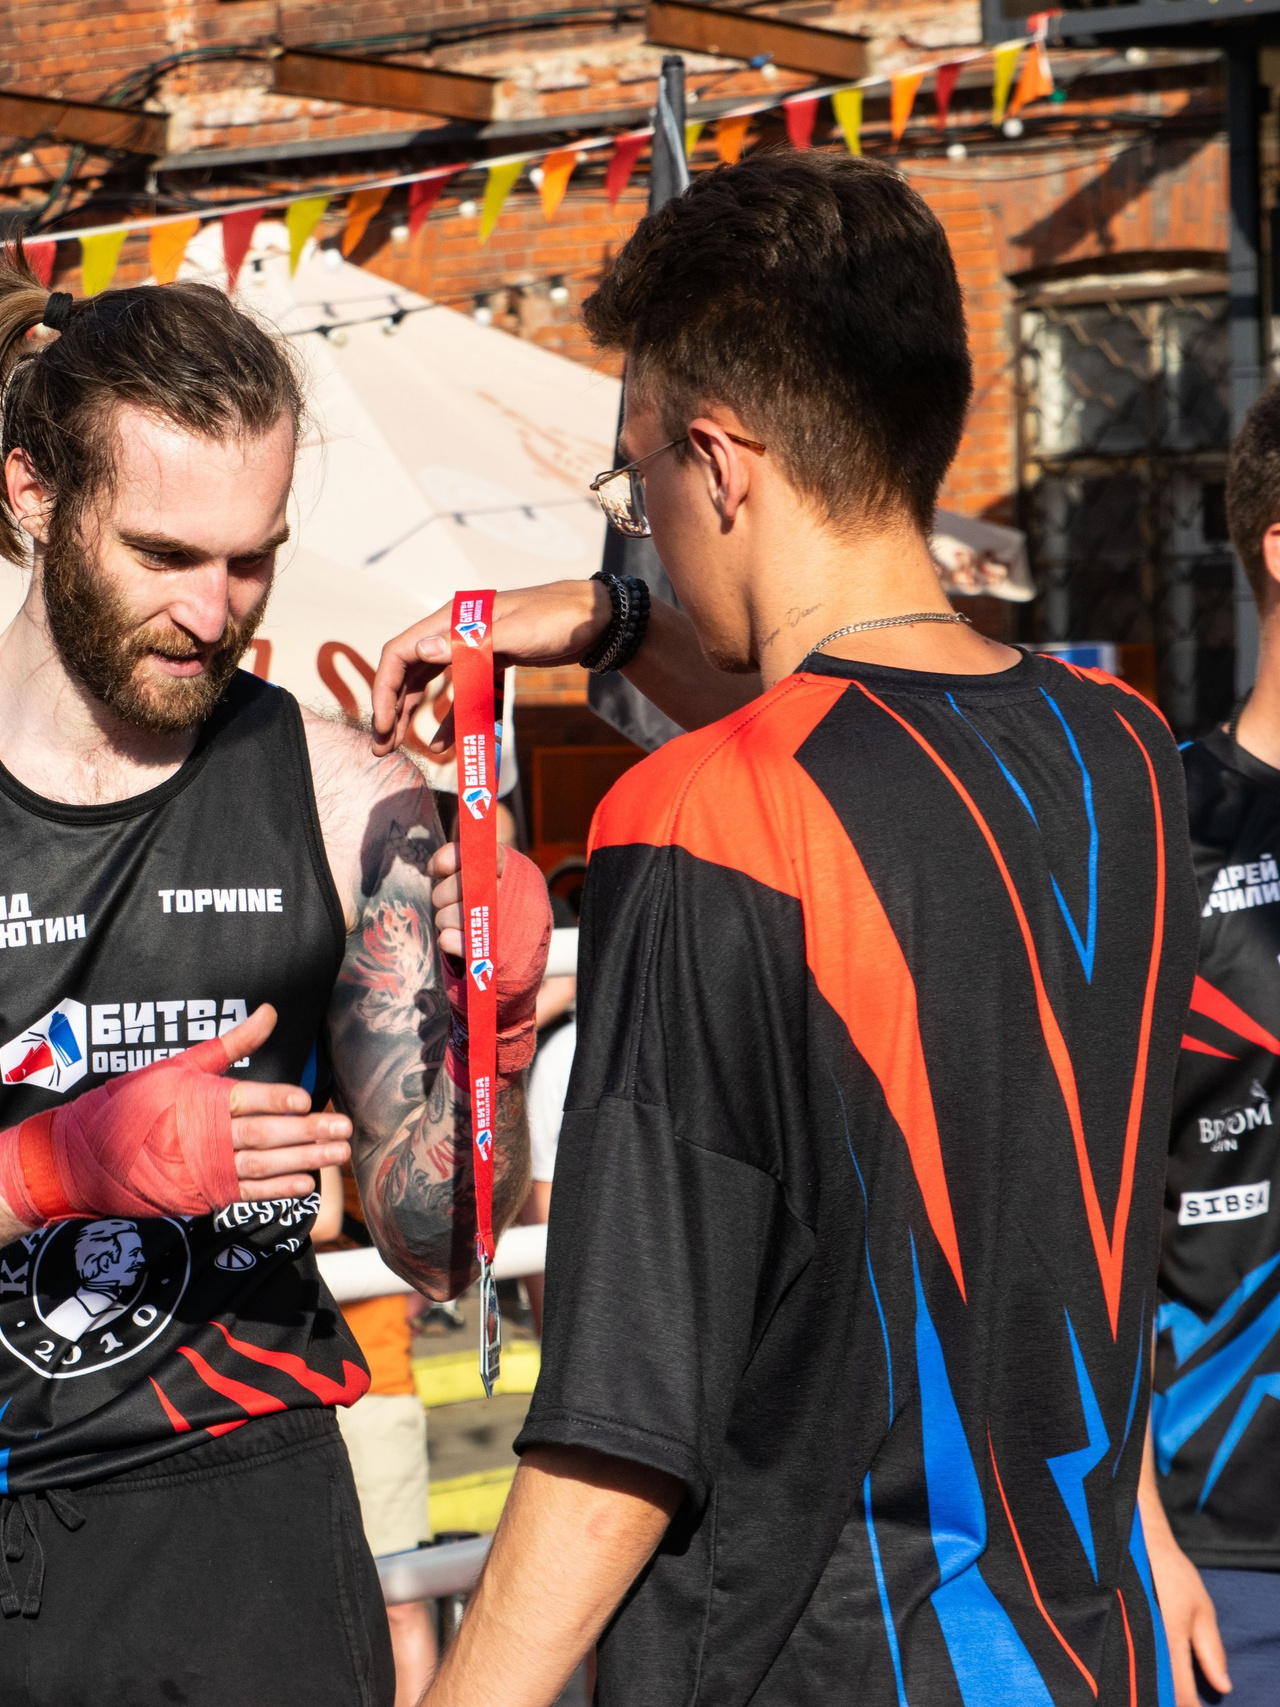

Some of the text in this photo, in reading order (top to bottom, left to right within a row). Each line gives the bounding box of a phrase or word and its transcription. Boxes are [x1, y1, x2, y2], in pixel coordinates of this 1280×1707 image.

[463, 734, 478, 786] БИТВА
[478, 734, 486, 785] ОБЩЕПИТОВ
[158, 888, 283, 913] TOPWINE
[470, 905, 483, 958] БИТВА
[482, 905, 490, 957] ОБЩЕПИТОВ
[91, 998, 248, 1046] БИТВА
[475, 1077, 487, 1130] БИТВА
[33, 1303, 158, 1365] 2010
